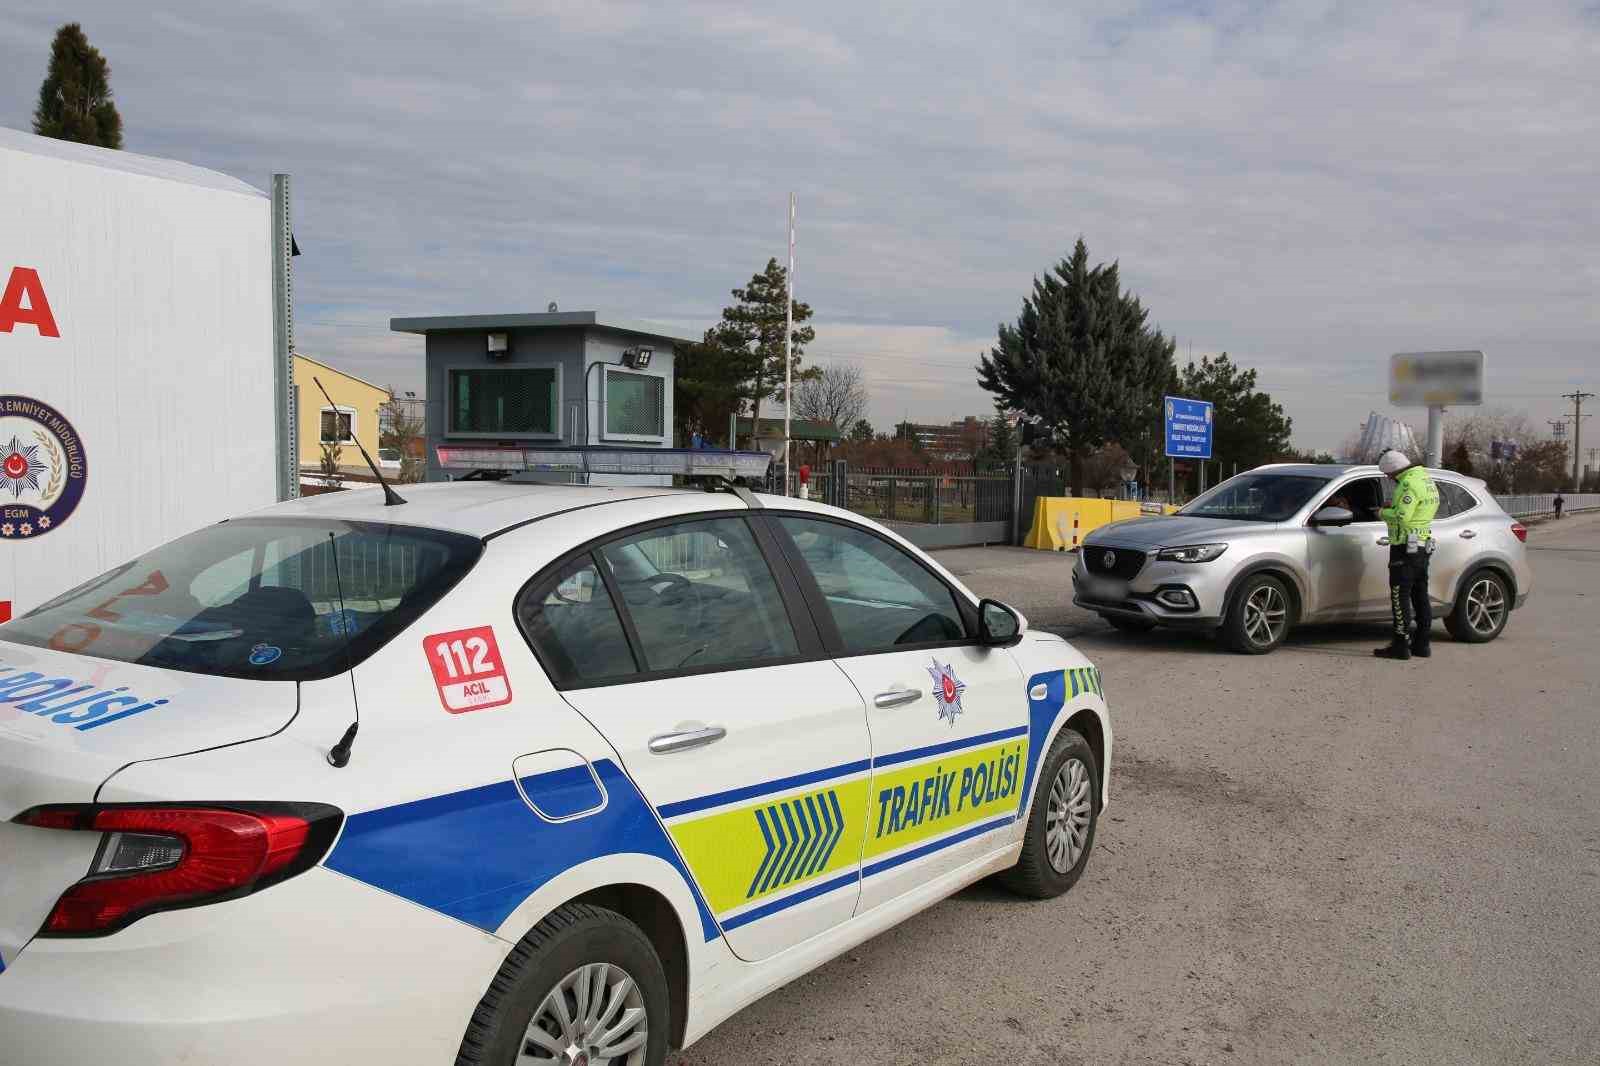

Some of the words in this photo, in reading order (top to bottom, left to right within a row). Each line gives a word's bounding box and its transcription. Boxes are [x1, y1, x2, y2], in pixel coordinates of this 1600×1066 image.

[6, 402, 51, 420] EMNİYET
[5, 509, 28, 518] EGM
[436, 636, 496, 678] 112
[876, 766, 956, 838] TRAFİK
[957, 745, 1021, 812] POLİSİ
